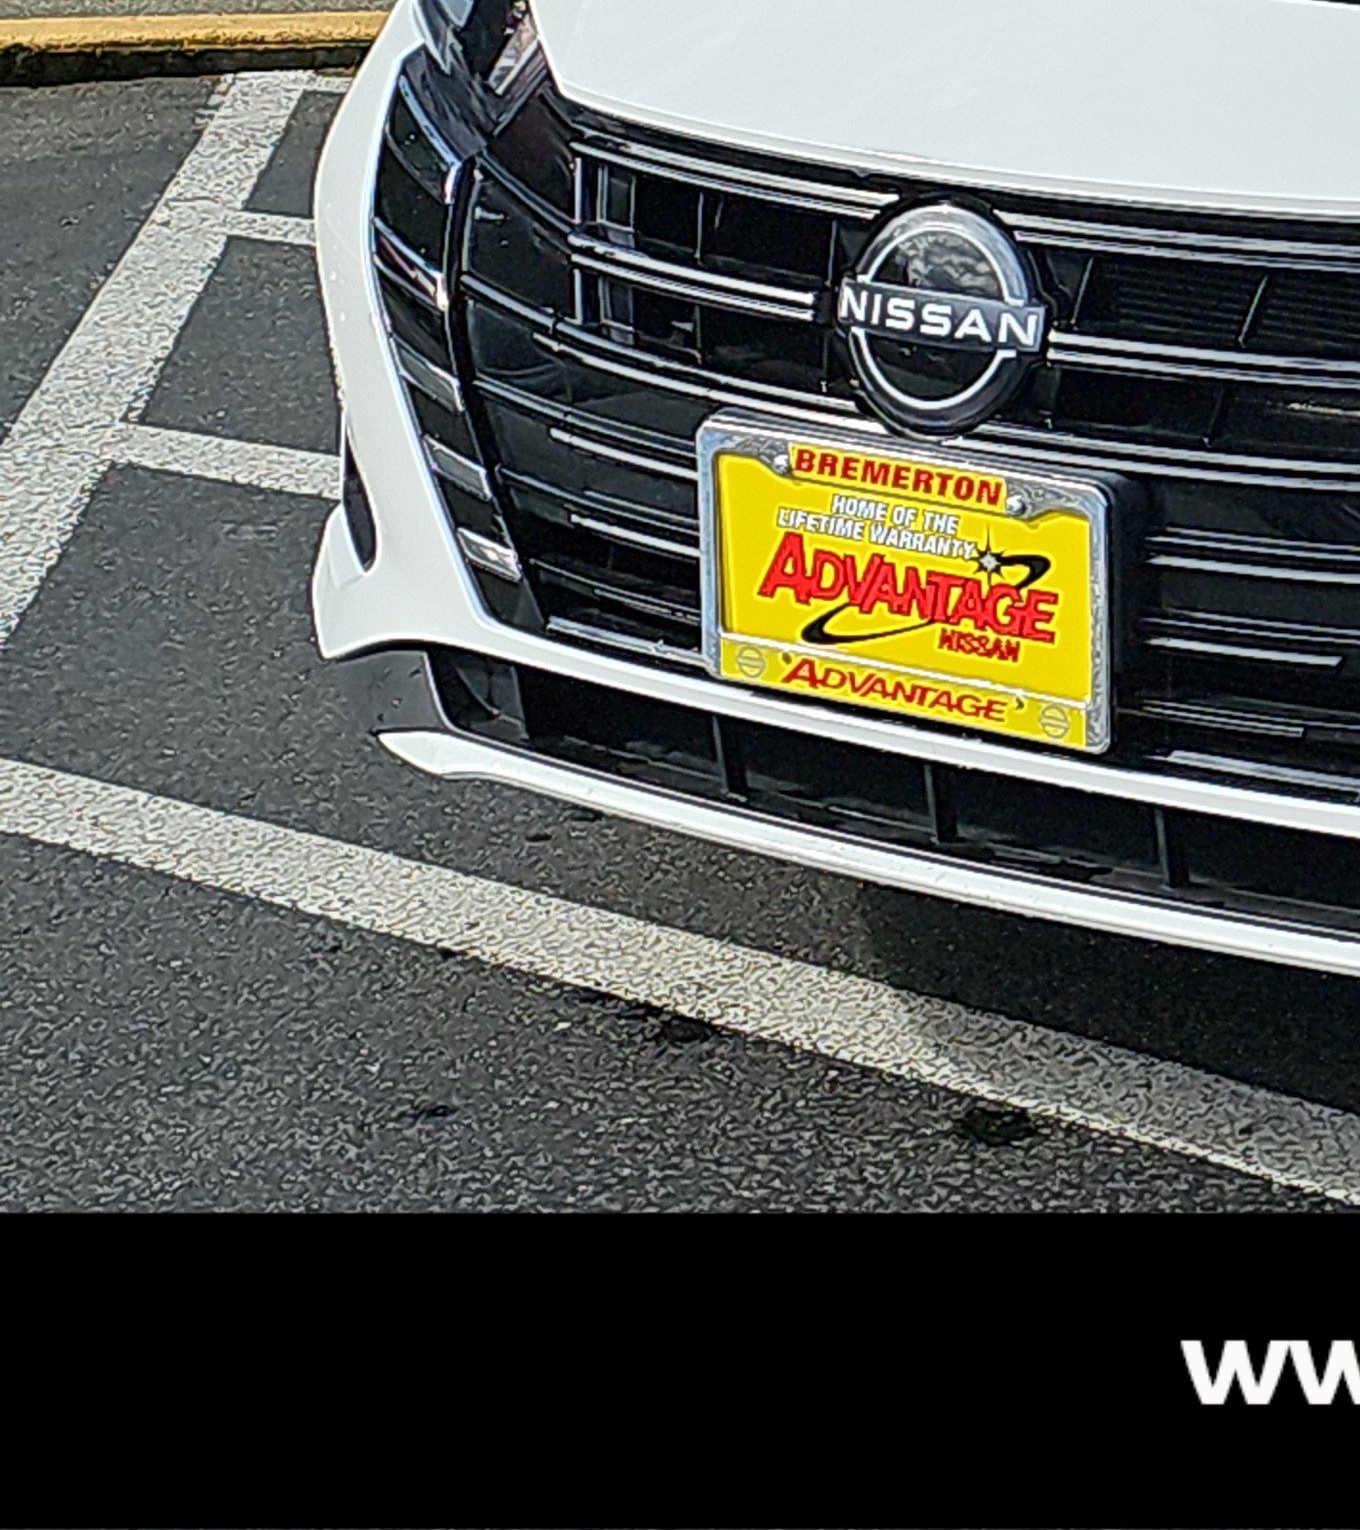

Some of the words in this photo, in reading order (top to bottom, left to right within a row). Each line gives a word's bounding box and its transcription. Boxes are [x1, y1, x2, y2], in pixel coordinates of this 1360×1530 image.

[840, 287, 1038, 346] NISSAN
[795, 448, 1002, 506] BREMERTON
[778, 509, 864, 541] LIFETIME
[870, 524, 976, 560] WARRANTY
[831, 495, 887, 524] HOME
[892, 506, 919, 526] OF
[923, 512, 959, 534] THE
[758, 532, 1059, 643] ADVANTAGE
[938, 628, 1020, 661] NISSAN
